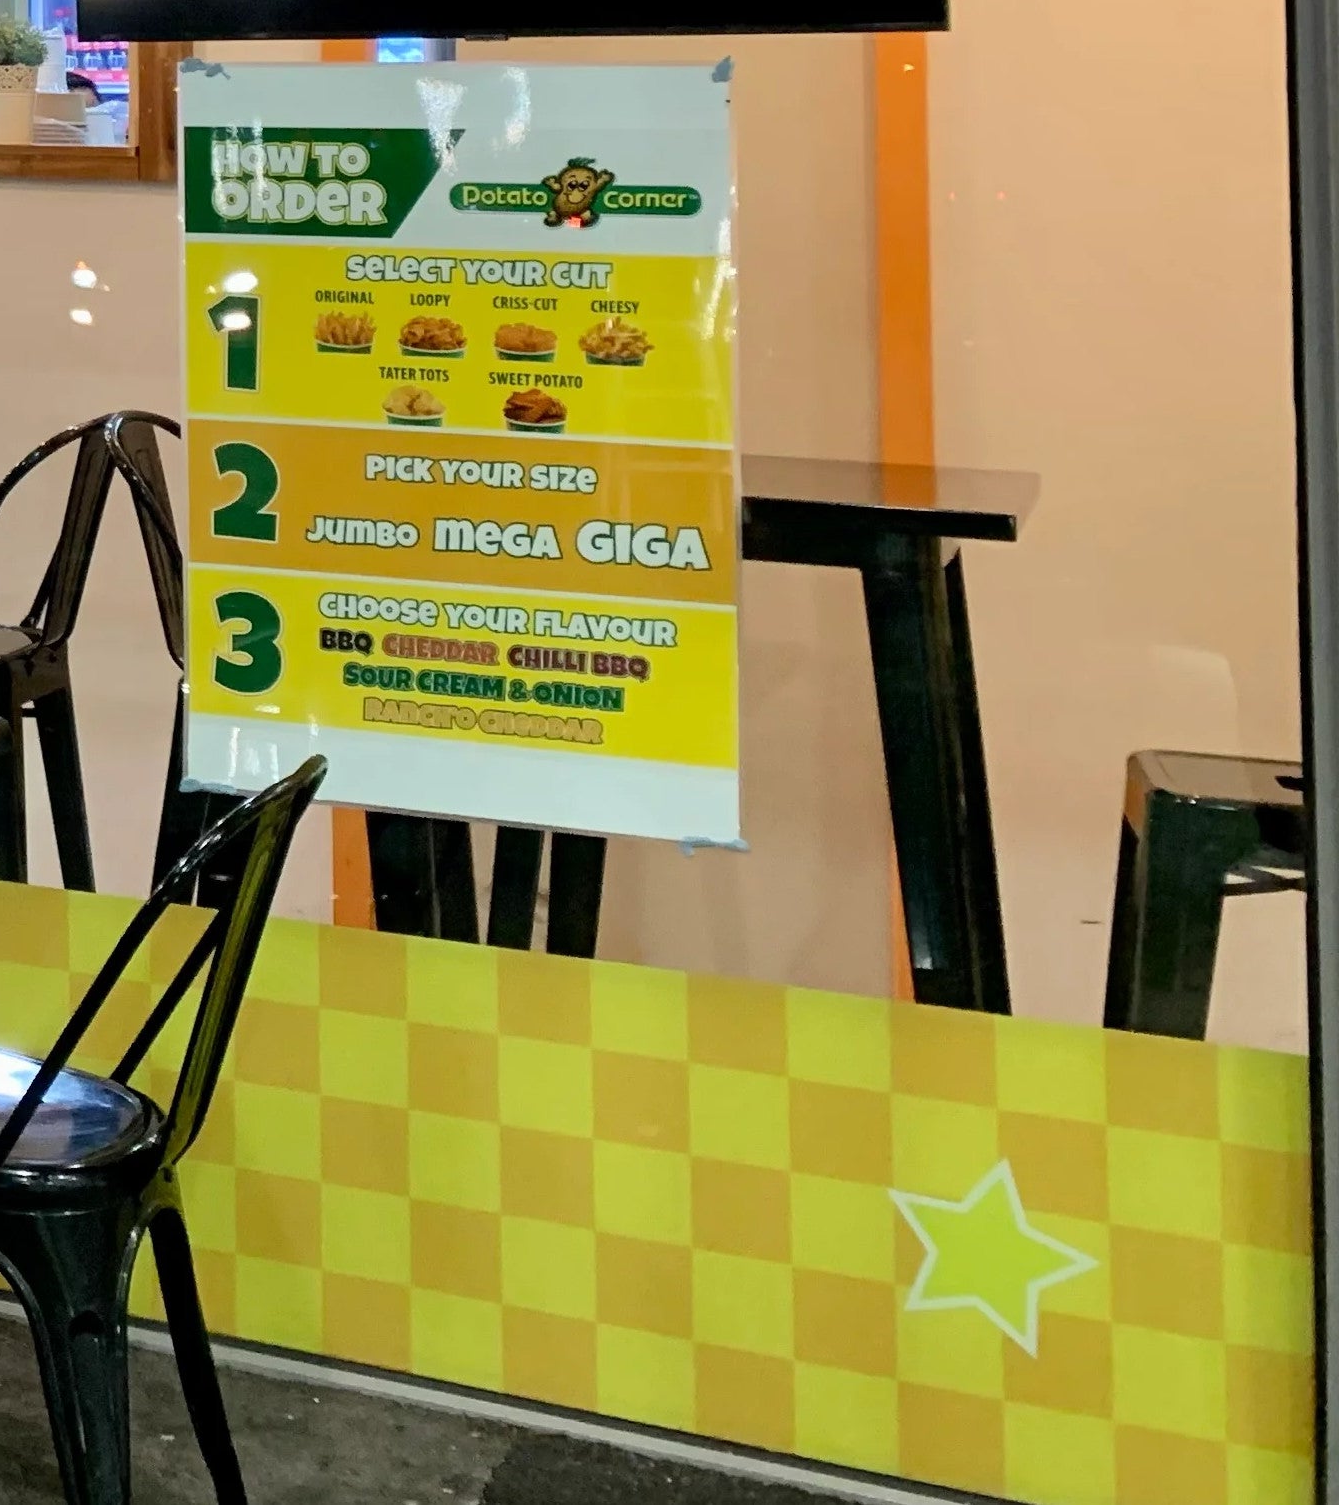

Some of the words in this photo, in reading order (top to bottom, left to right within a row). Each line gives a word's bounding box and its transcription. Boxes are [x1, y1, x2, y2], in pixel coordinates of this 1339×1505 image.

[214, 140, 310, 178] HOW
[313, 142, 370, 179] TO
[462, 186, 548, 208] Potato
[346, 255, 457, 284] SELECT
[462, 258, 546, 287] YOUR
[550, 261, 613, 289] CUT
[314, 290, 375, 306] ORIGINAL
[409, 292, 451, 308] LOOPY
[492, 296, 558, 312] CRISS-CUT
[591, 299, 640, 315] CHEESY
[206, 294, 262, 392] 1
[379, 366, 416, 382] TATER
[419, 367, 450, 383] TOTS
[488, 371, 530, 387] SWEET
[532, 372, 584, 389] POTATO
[365, 454, 439, 484] PICK
[441, 458, 524, 489] YOUR
[212, 441, 281, 545] 2
[575, 520, 711, 572] GIGA
[214, 590, 283, 694] 3
[443, 602, 531, 635] YOUR
[533, 610, 678, 648] FLAVOUR
[320, 628, 373, 655] BBQ
[382, 632, 499, 666] CHEDDAR
[507, 644, 588, 675] CHILLI
[590, 651, 651, 682] BBQ
[343, 662, 414, 692] SOUR
[416, 669, 507, 701] CREAM
[508, 679, 525, 702] &
[526, 682, 625, 712] ONION
[478, 707, 604, 745] CHEDDAR
